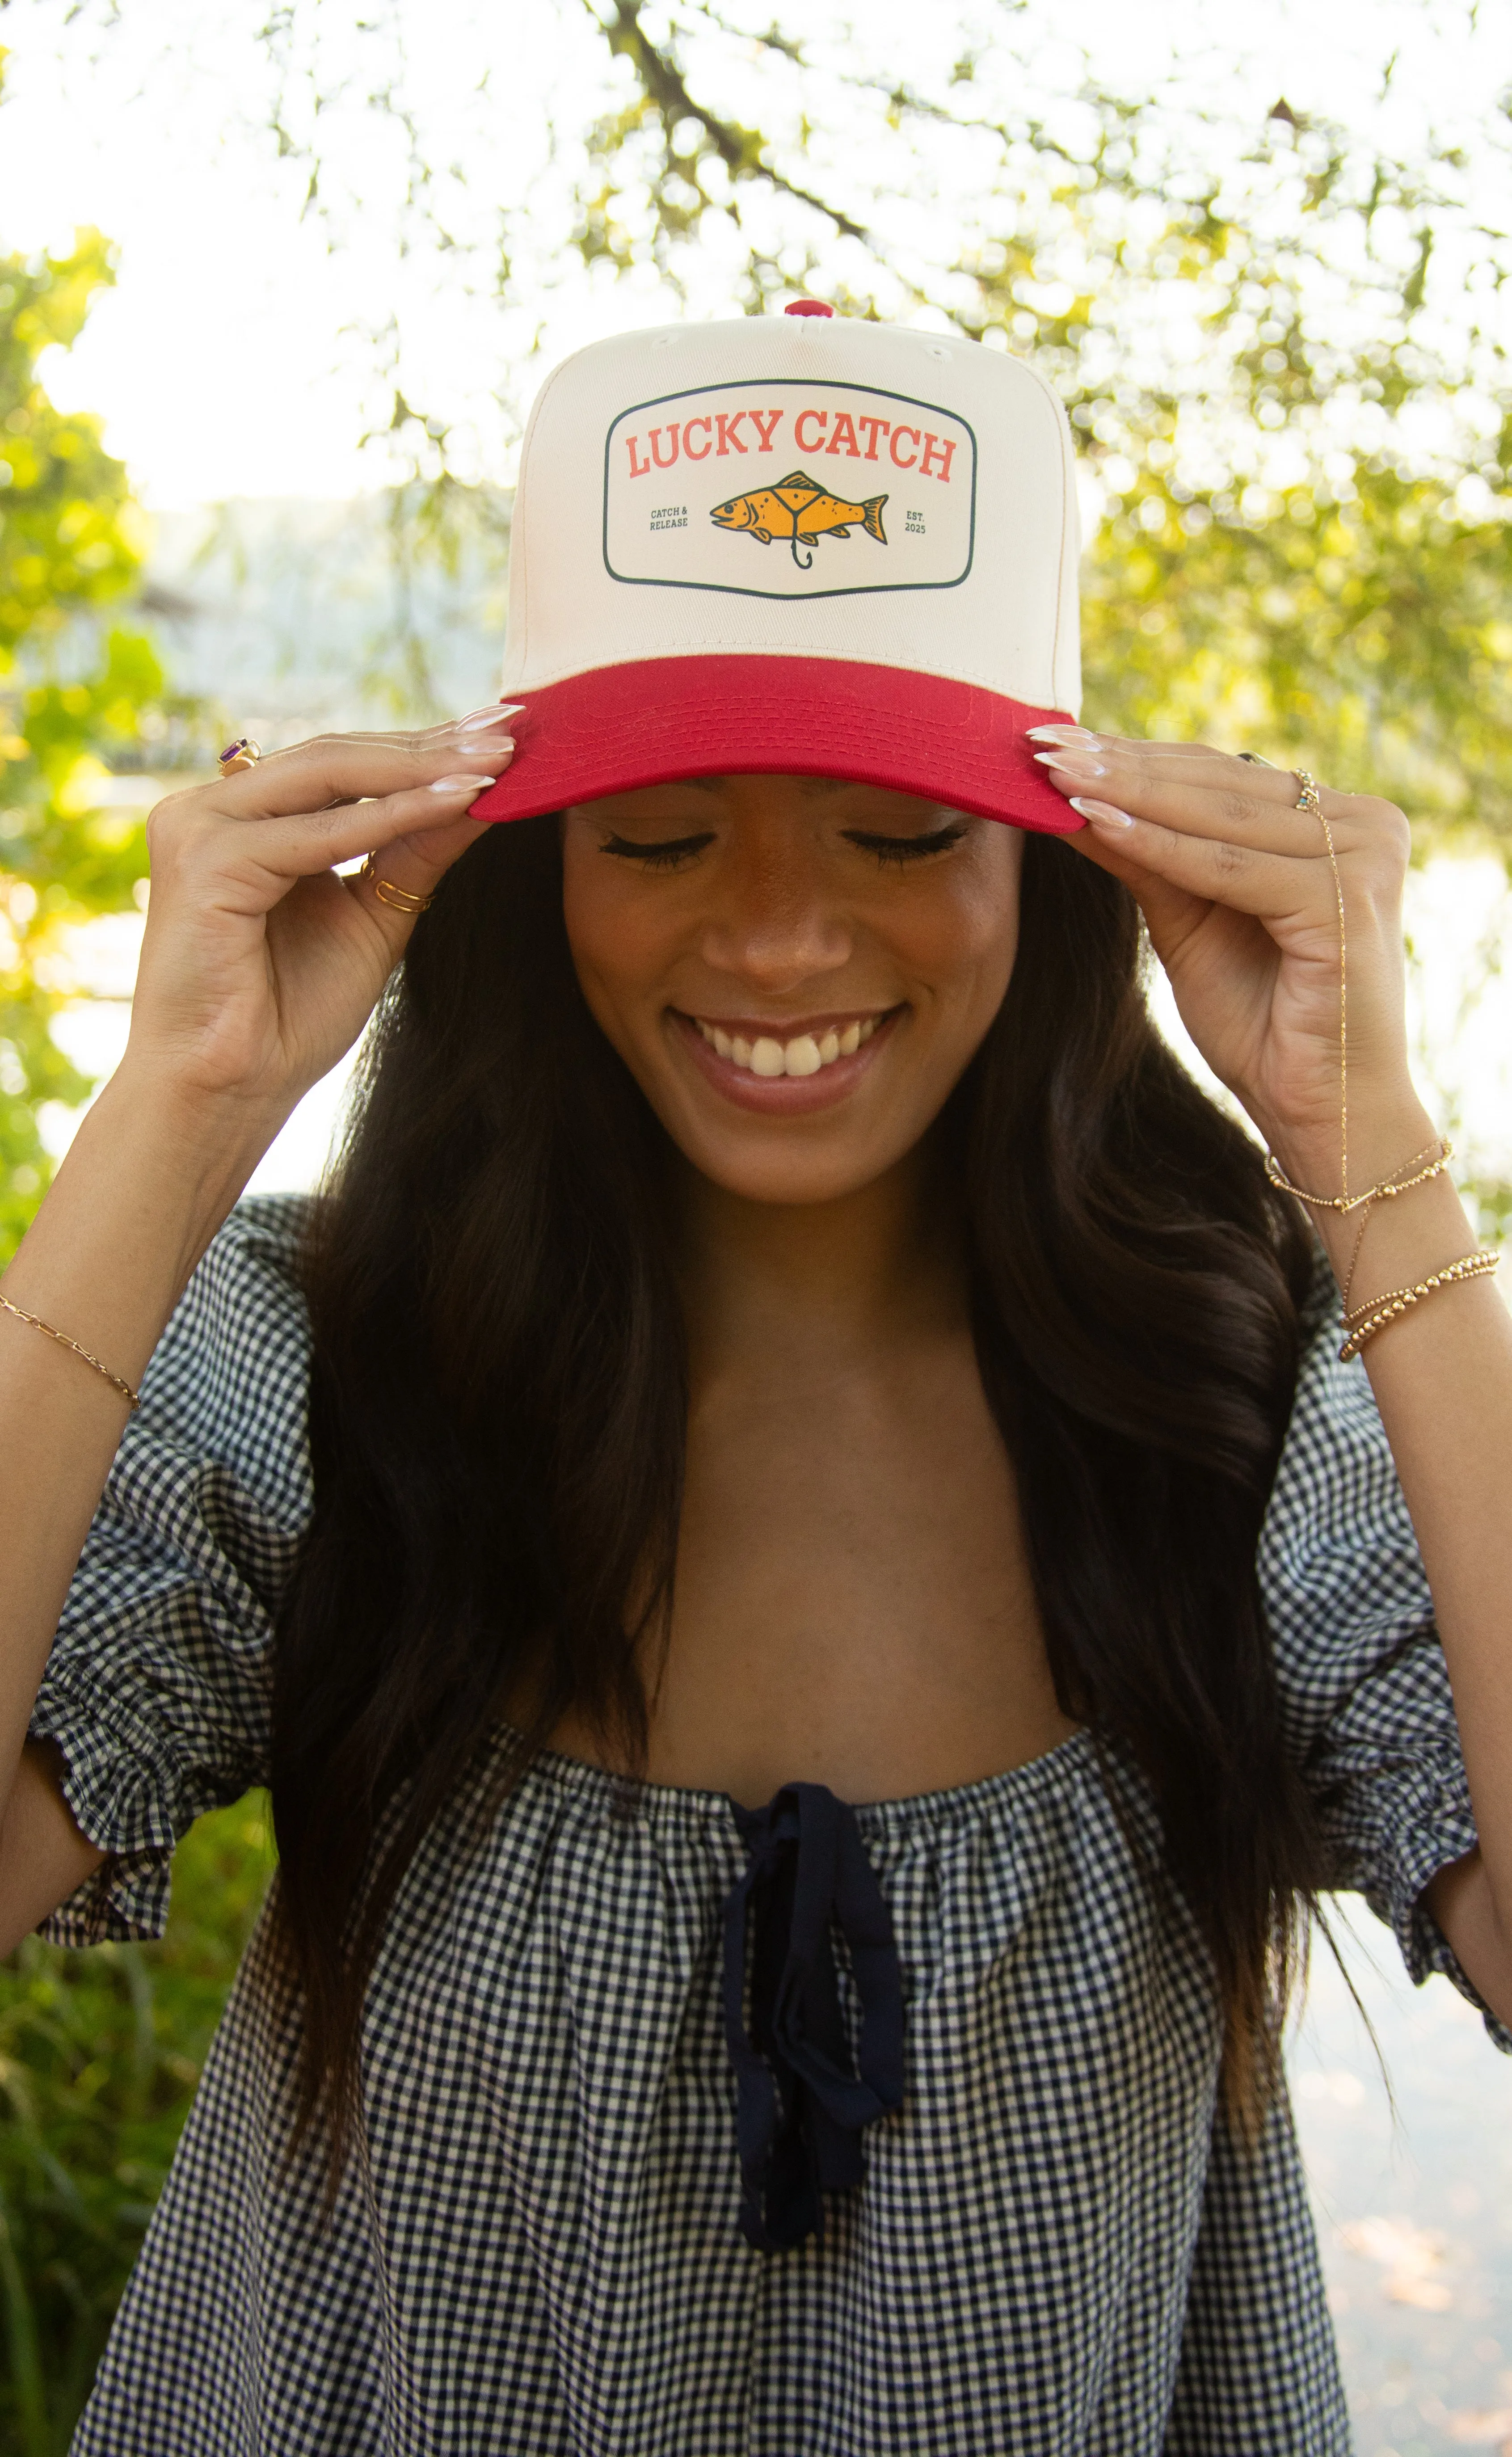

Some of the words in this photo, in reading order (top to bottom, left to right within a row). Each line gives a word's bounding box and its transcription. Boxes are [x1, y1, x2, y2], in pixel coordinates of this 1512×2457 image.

[626, 410, 783, 478] LUCKY
[795, 410, 957, 483] CATCH
[651, 507, 680, 518] CATCH
[682, 506, 687, 515] &
[906, 511, 924, 522] EST.
[650, 518, 688, 531] RELEASE
[905, 523, 926, 534] 2025
